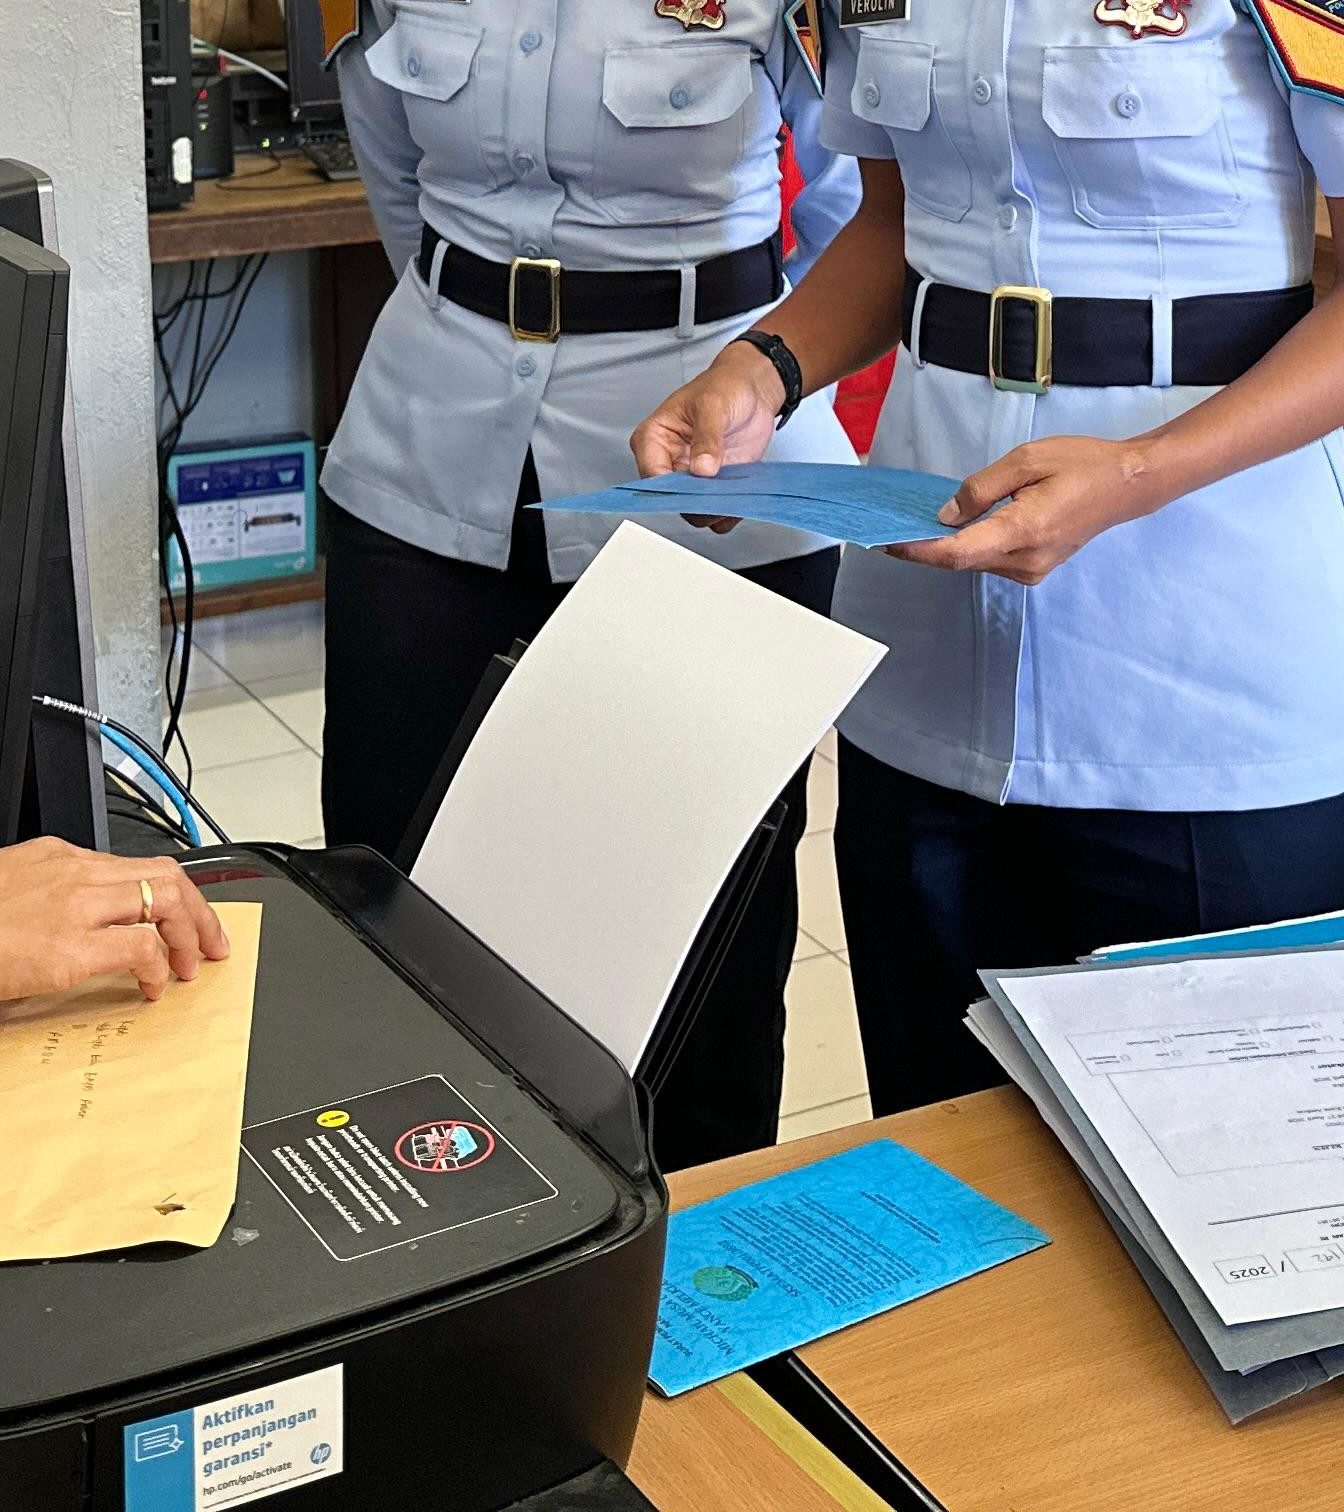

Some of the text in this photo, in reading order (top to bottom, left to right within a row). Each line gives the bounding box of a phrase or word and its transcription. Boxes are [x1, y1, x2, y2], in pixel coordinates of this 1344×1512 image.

[1229, 1265, 1268, 1279] 2025
[201, 1396, 275, 1431] Aktifkan
[202, 1406, 317, 1456] perpanjangan
[311, 1443, 331, 1465] hp
[202, 1461, 293, 1496] hp.com/go/activate
